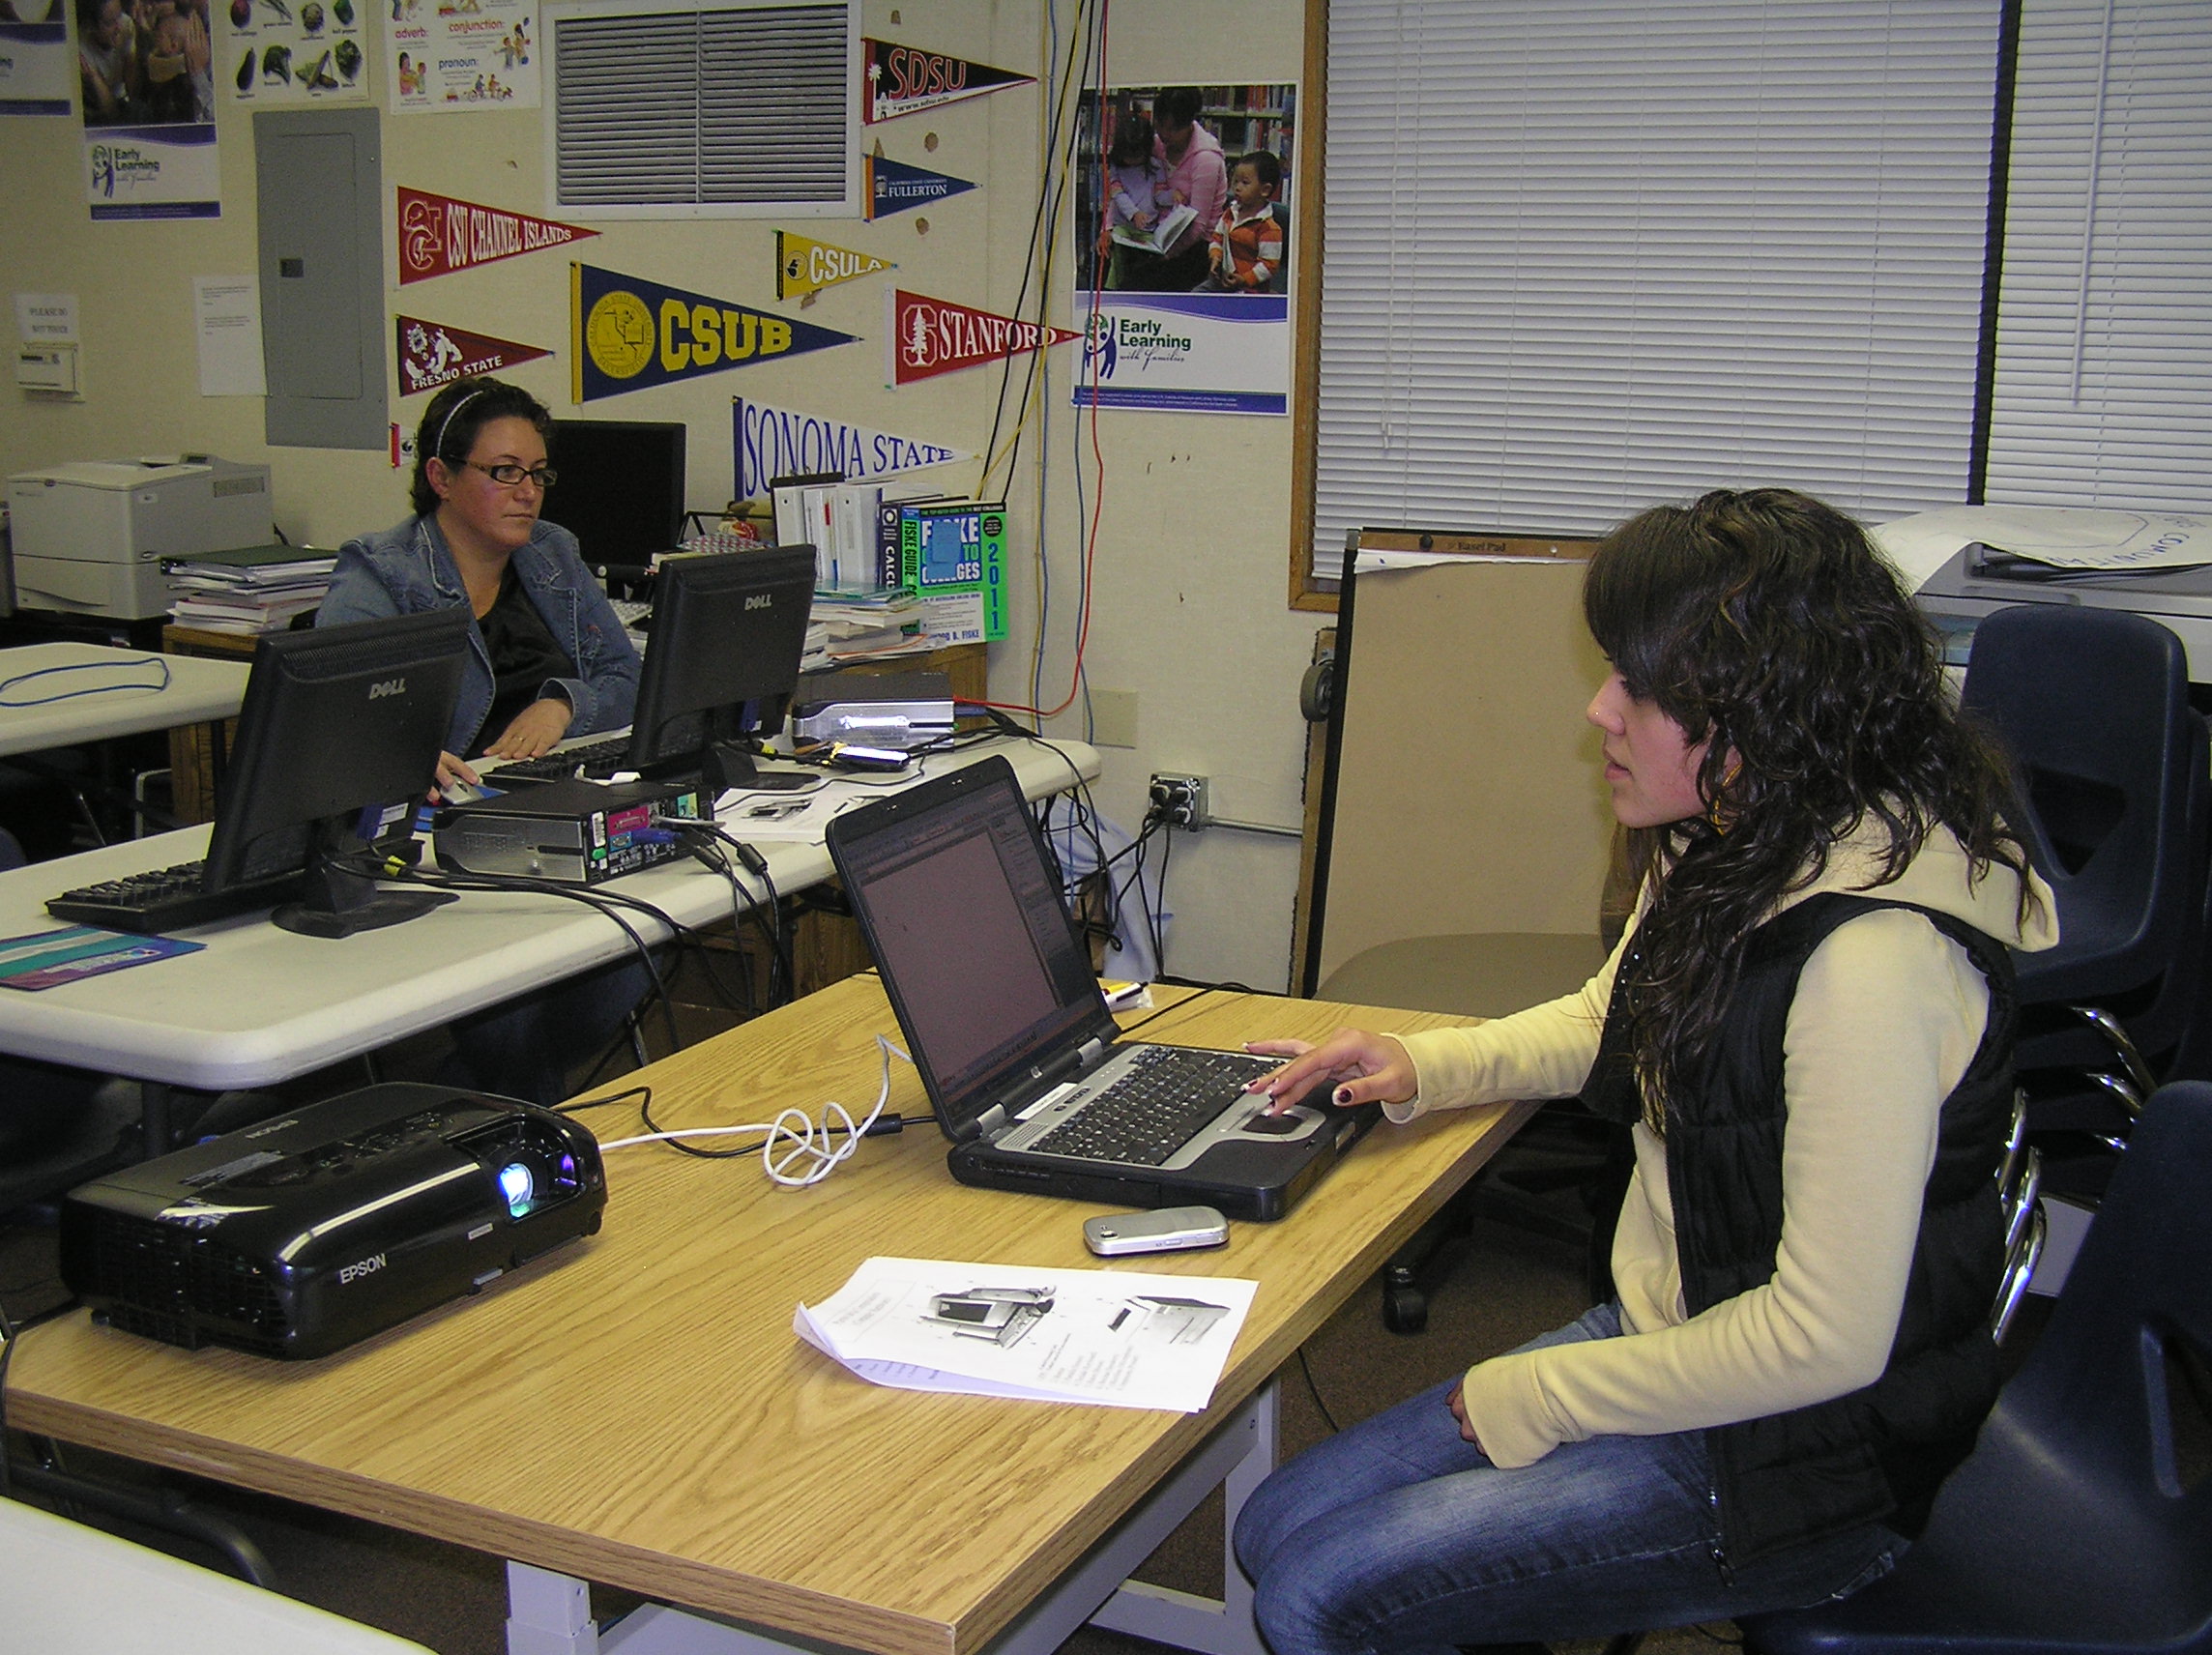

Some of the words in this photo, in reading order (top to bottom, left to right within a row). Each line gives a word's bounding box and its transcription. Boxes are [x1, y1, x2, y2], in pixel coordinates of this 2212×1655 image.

[395, 27, 428, 39] adverb:
[449, 19, 506, 34] conjunction:
[439, 58, 479, 71] pronoun:
[888, 47, 967, 101] SDSU
[115, 148, 140, 161] Early
[116, 160, 160, 172] Learning
[889, 185, 947, 197] FULLERTON
[448, 203, 469, 269] CSU
[471, 209, 522, 263] CHANNEL
[523, 220, 572, 249] ISLANDS
[809, 246, 884, 284] CSULA
[660, 298, 792, 372] CSUB
[940, 308, 1058, 362] STANFORD
[1120, 319, 1162, 335] Early
[1120, 334, 1192, 351] Learning
[411, 368, 460, 391] FRESNO
[463, 355, 504, 377] STATE
[743, 404, 865, 497] SONOMA
[873, 434, 955, 473] STATE
[904, 521, 917, 547] FISKE
[904, 548, 917, 576] GUIDE
[963, 543, 979, 561] TO
[744, 594, 772, 611] DELL
[369, 678, 406, 700] DELL
[340, 1253, 387, 1284] EPSON
